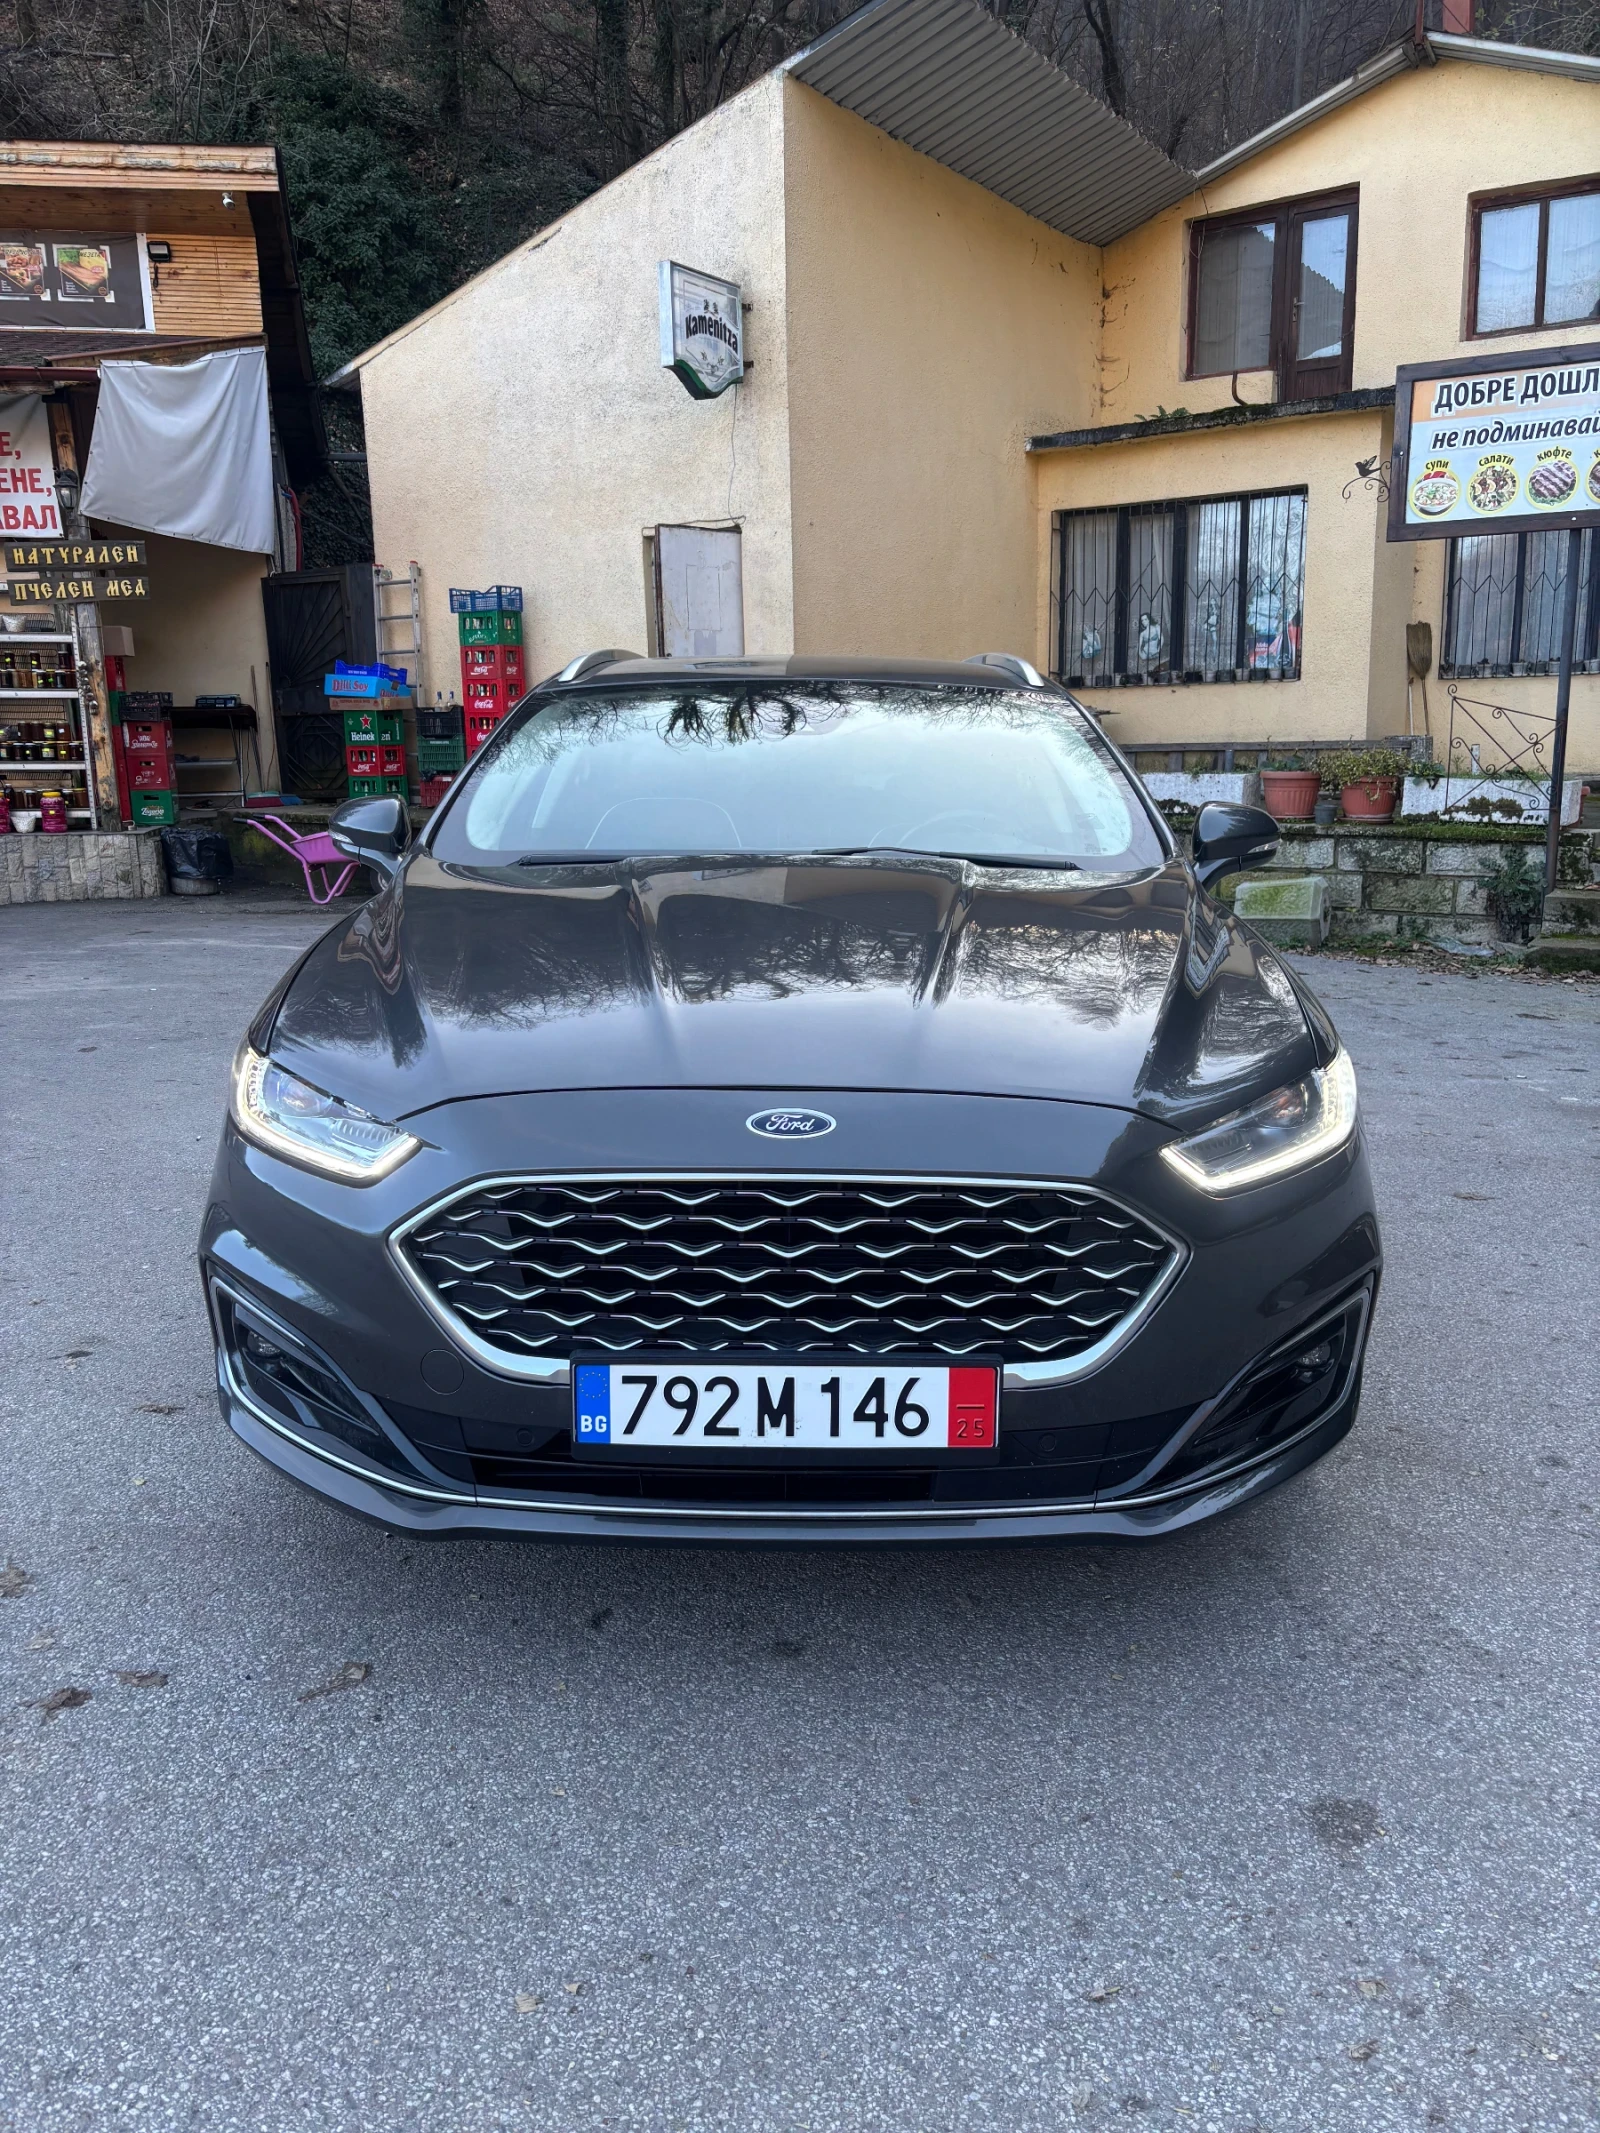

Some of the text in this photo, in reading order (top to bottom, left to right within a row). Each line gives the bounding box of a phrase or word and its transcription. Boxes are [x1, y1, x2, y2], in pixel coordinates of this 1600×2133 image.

[685, 314, 739, 352] Kamenitza
[1434, 377, 1515, 414] ДОБРЕ
[1431, 430, 1458, 450] не
[1478, 454, 1514, 467] салати
[1536, 446, 1572, 462] кюфте
[1425, 460, 1449, 471] супи
[0, 505, 58, 530] ВАЛ
[12, 545, 139, 565] НАТУРАЛЕН
[14, 578, 146, 600] ПЧЕЛЕН МЕД
[765, 1114, 815, 1132] Ford
[580, 1415, 608, 1434] BG
[956, 1418, 986, 1439] 25
